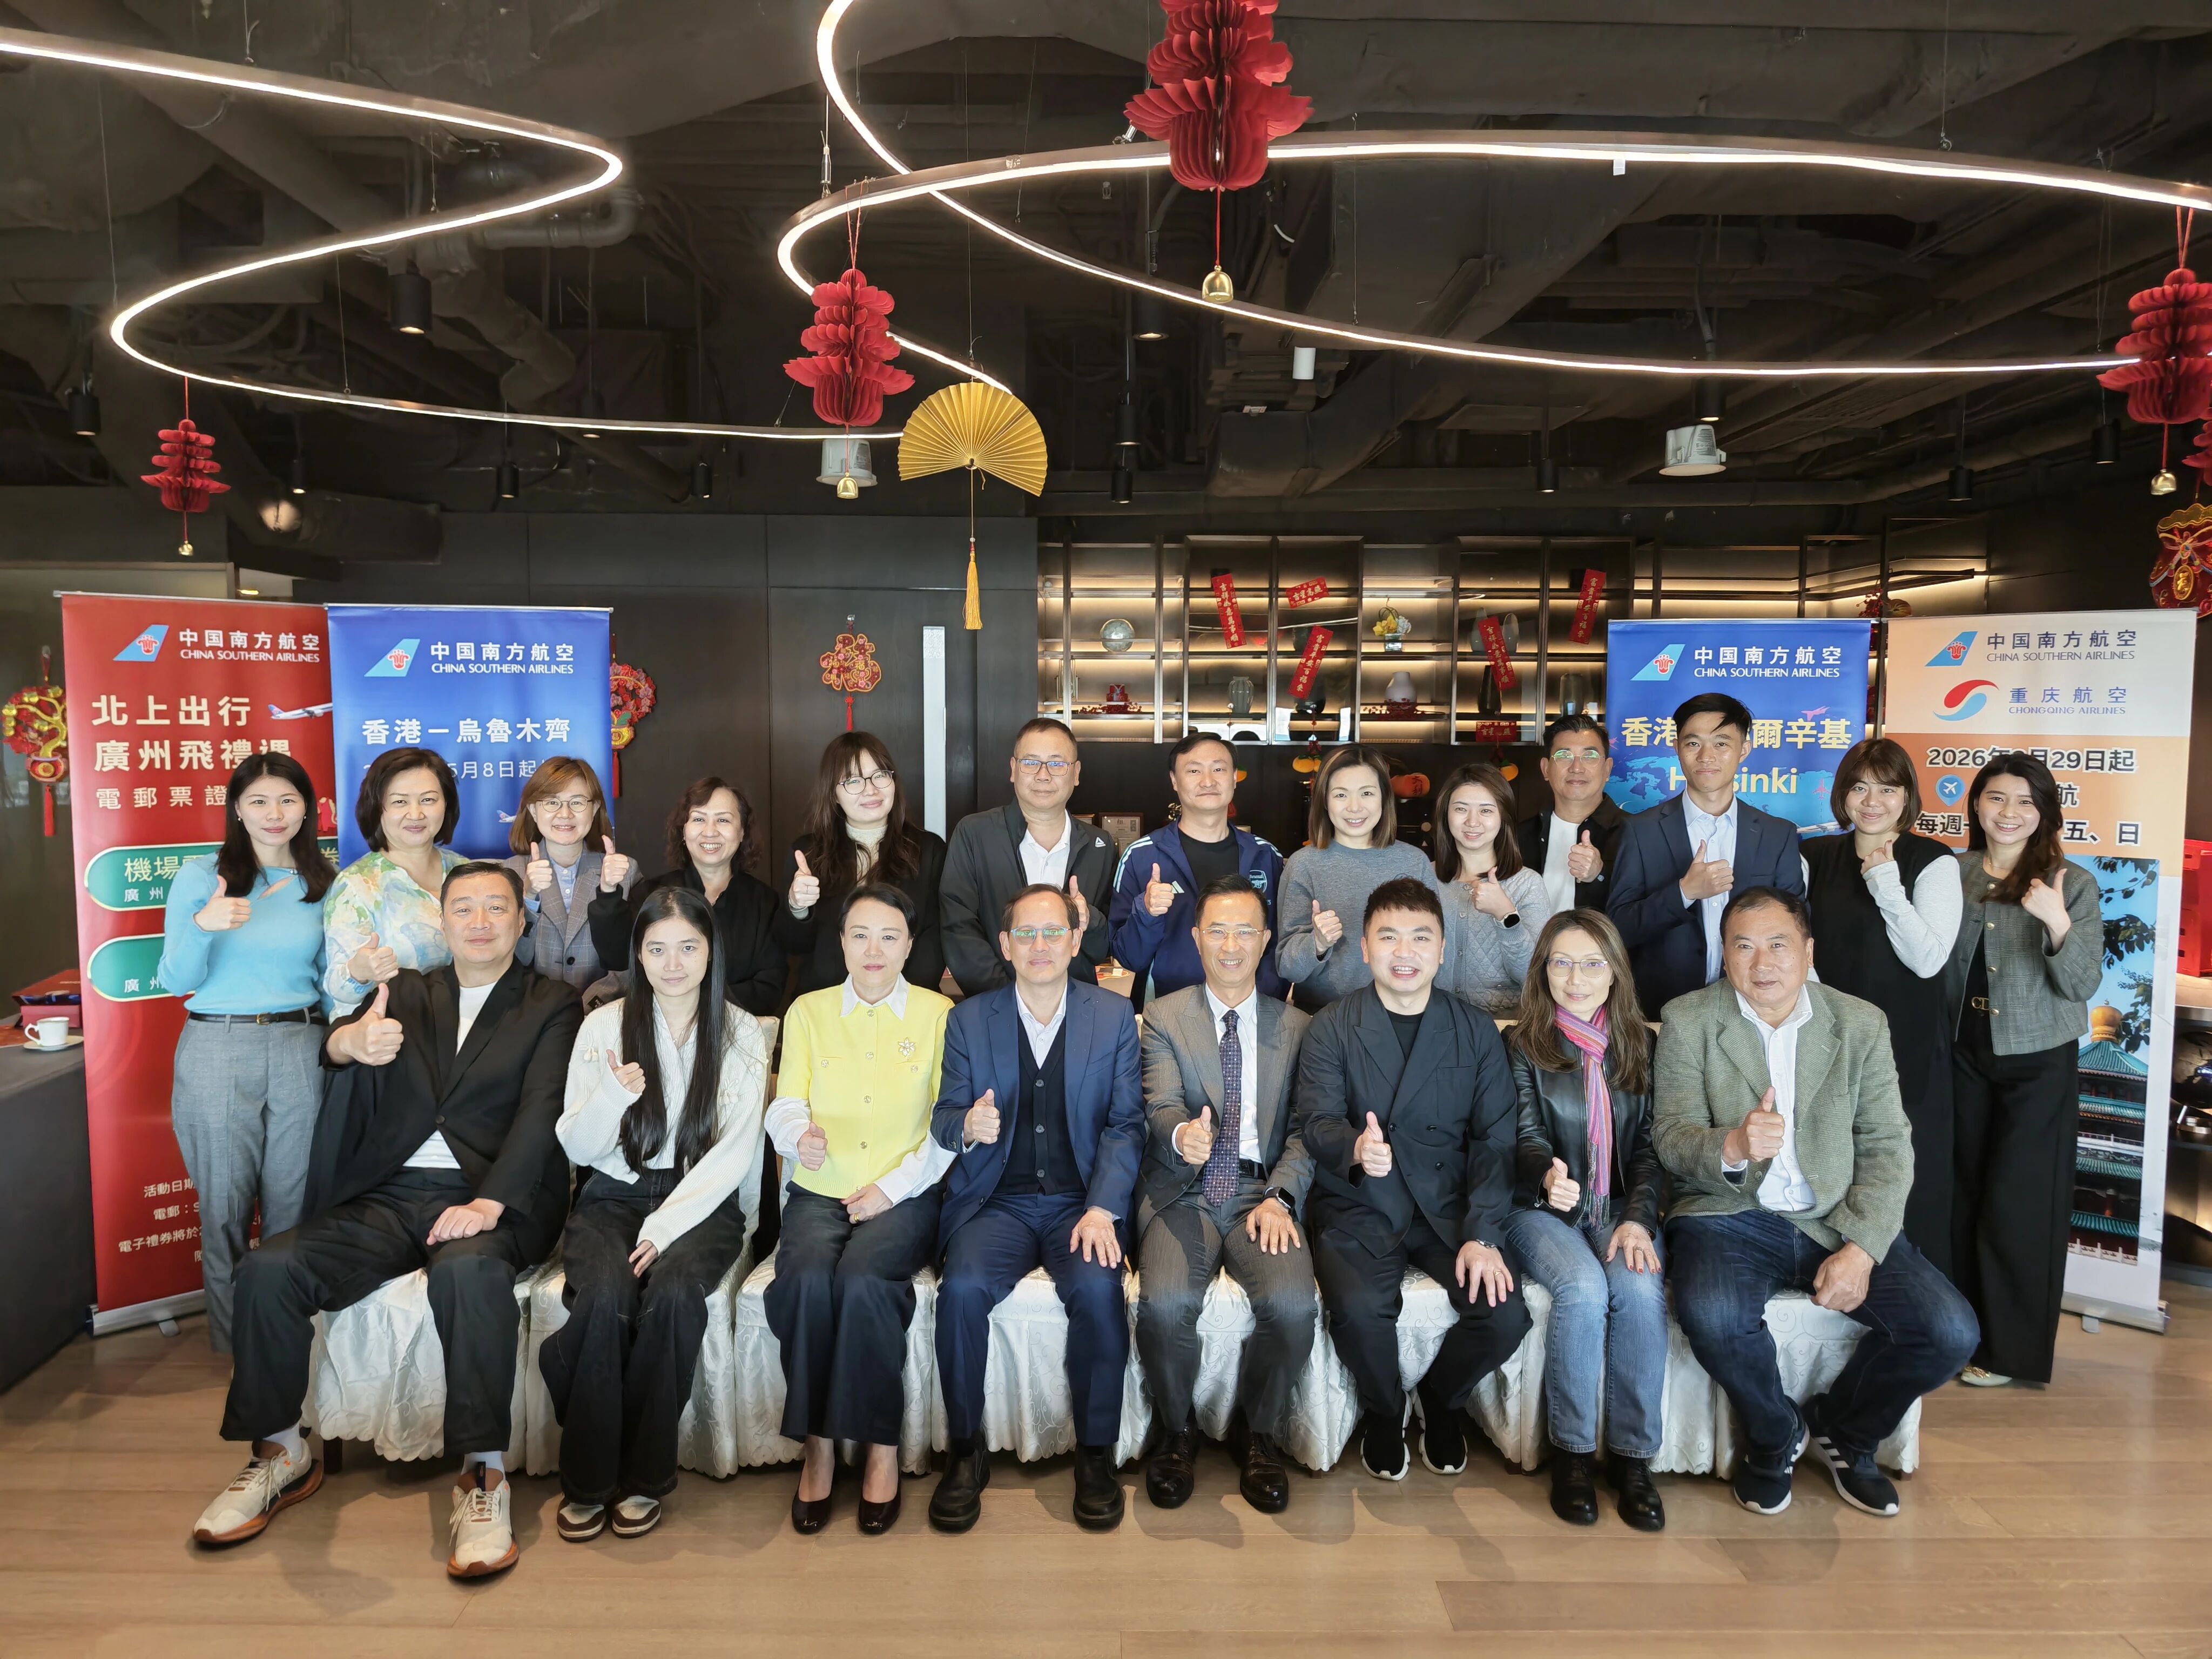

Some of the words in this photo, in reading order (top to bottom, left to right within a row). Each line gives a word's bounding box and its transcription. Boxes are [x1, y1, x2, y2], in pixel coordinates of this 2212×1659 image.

[179, 628, 320, 651] 中国南方航空
[1987, 629, 2137, 650] 中国南方航空
[180, 650, 214, 660] CHINA
[217, 651, 273, 661] SOUTHERN
[276, 652, 320, 663] AIRLINES
[430, 641, 574, 662] 中国南方航空
[1694, 646, 1842, 665] 中国南方航空
[1987, 652, 2019, 662] CHINA
[2022, 651, 2082, 661] SOUTHERN
[2085, 650, 2135, 660] AIRLINES
[432, 663, 466, 673] CHINA
[468, 663, 525, 674] SOUTHERN
[528, 664, 574, 675] AIRLINES
[1694, 667, 1727, 677] CHINA
[1730, 668, 1789, 677] SOUTHERN
[1791, 668, 1840, 677] AIRLINES
[2009, 686, 2127, 704] 重庆航空
[91, 694, 251, 726] 北上出行
[2008, 706, 2075, 716] CHONGQING
[2078, 706, 2126, 715] AIRLINES
[1621, 716, 1852, 750] 香港爾辛基
[1928, 745, 2135, 772] 2026月29日起
[1669, 767, 1797, 794] Hsinki
[96, 785, 228, 809] 電郵票證
[118, 1226, 202, 1253] 電子禮券將於
